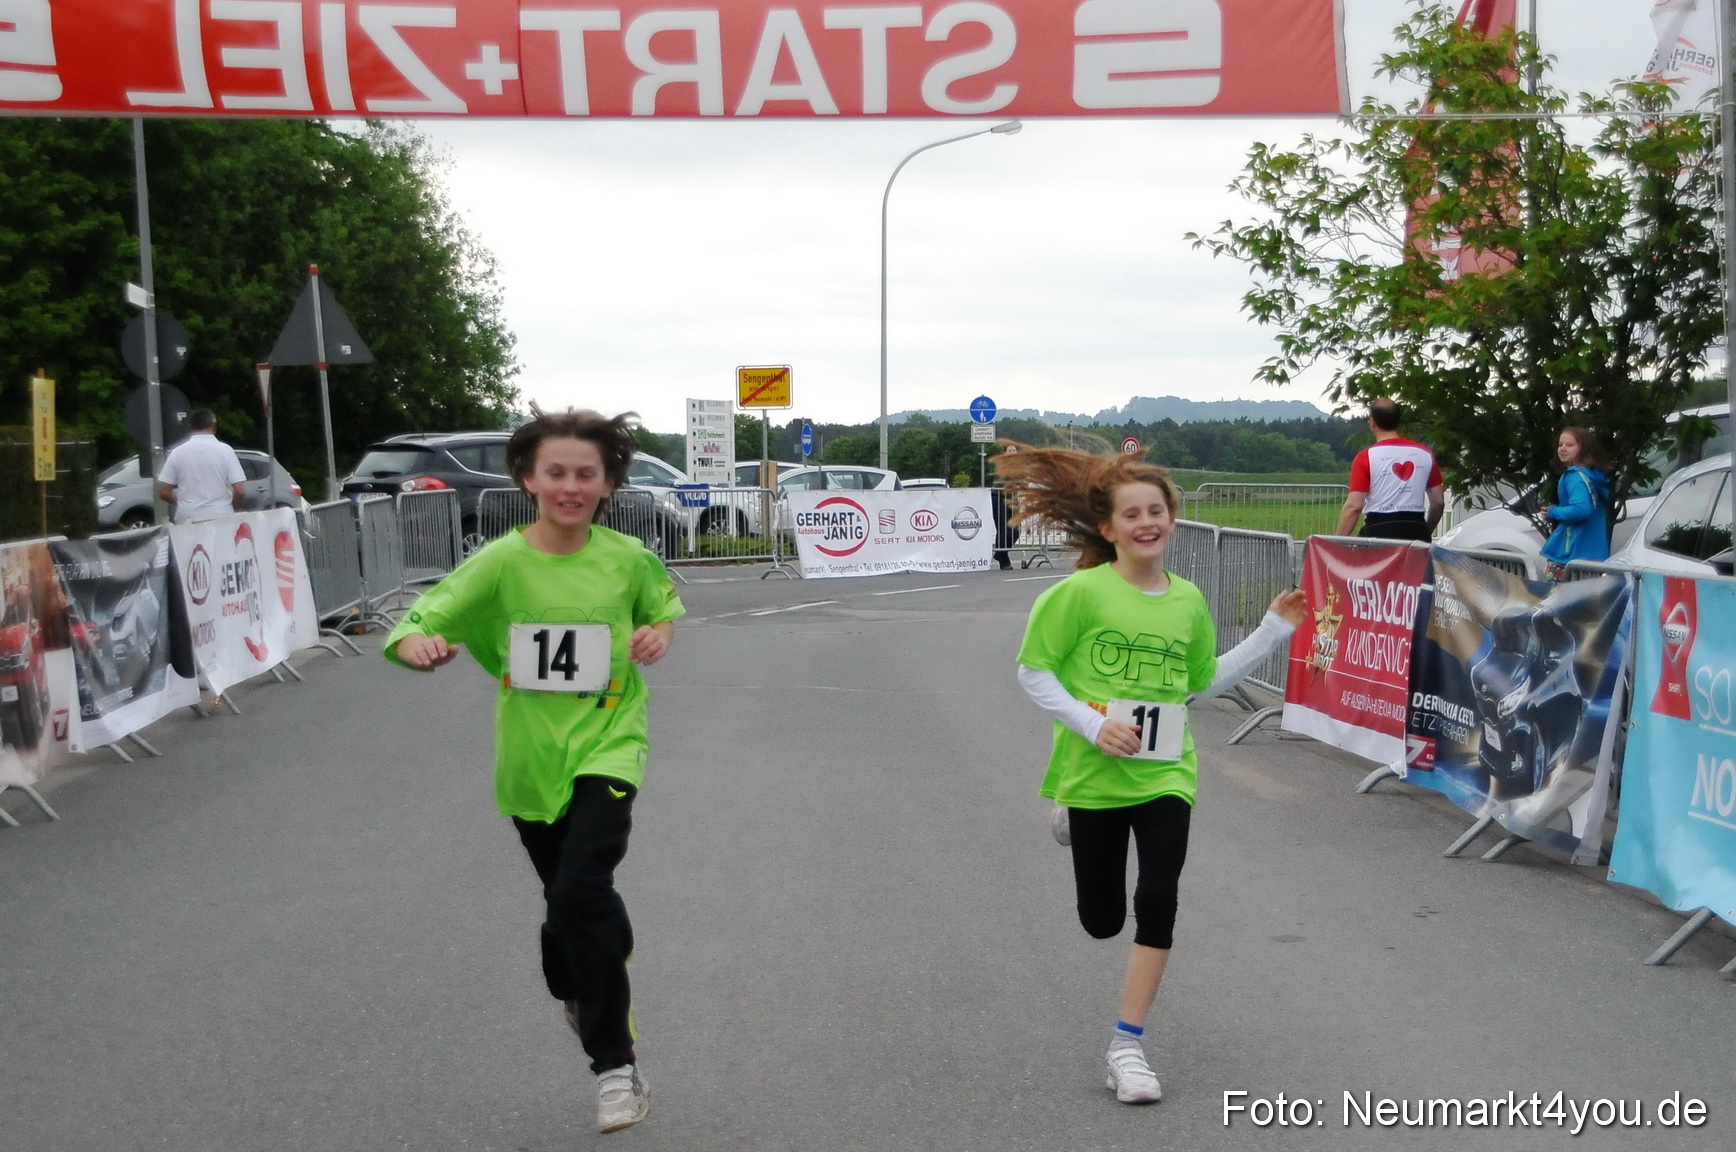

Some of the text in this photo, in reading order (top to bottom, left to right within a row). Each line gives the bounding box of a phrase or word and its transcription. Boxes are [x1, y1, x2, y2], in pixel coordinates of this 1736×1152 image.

[1126, 443, 1136, 454] 60
[797, 512, 861, 527] GERHART &
[914, 514, 934, 526] KIA
[954, 520, 980, 528] NISSAN
[824, 525, 864, 540] JÄNIG
[917, 534, 945, 543] MOTORS
[874, 537, 900, 545] SEAT
[805, 565, 826, 575] eumarkt
[918, 558, 989, 570] www.gerhart-jaenig.de
[192, 560, 208, 592] KIA
[1663, 627, 1687, 642] NISSAN
[533, 629, 580, 681] 14
[1411, 691, 1438, 711] DER
[1132, 704, 1161, 752] 11
